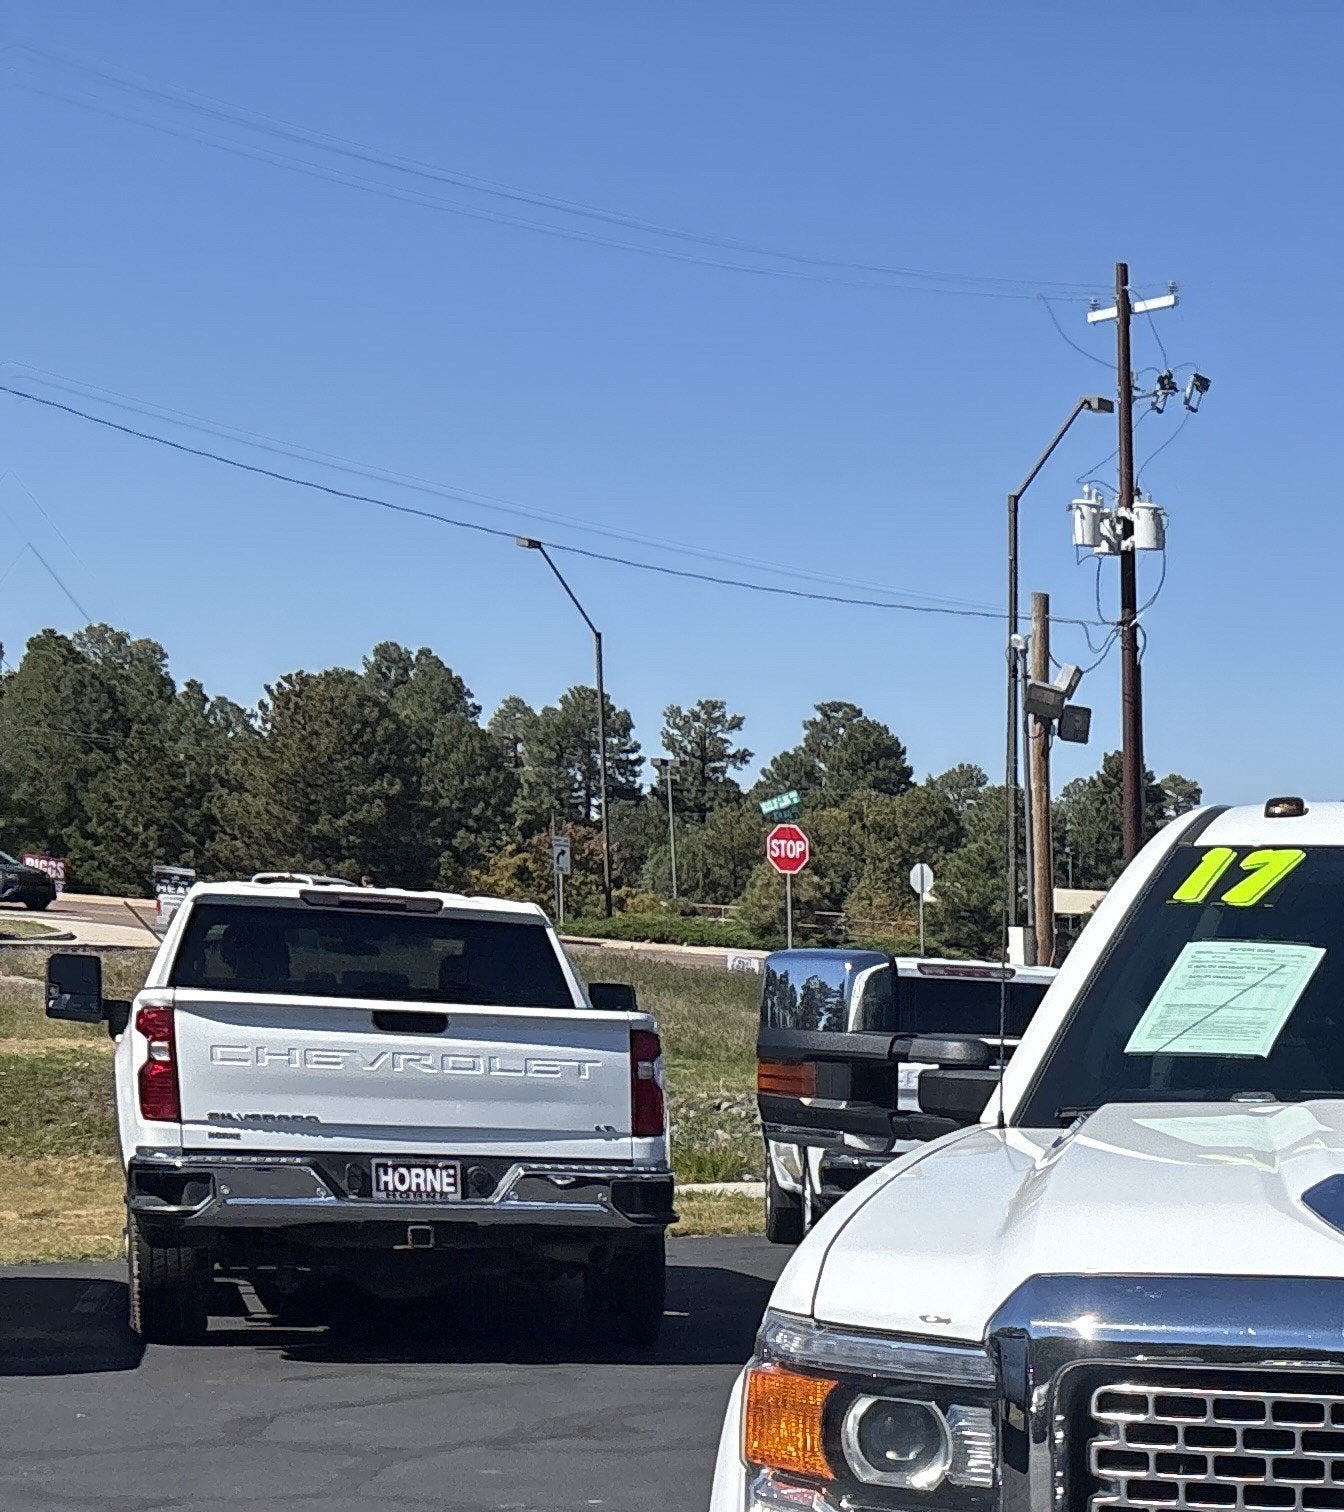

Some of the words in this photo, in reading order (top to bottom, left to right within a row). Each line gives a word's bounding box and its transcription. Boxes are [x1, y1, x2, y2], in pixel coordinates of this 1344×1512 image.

[771, 838, 805, 859] STOP
[1172, 847, 1307, 907] 17
[209, 1044, 602, 1079] CHEVROLET
[378, 1167, 456, 1192] HORNE
